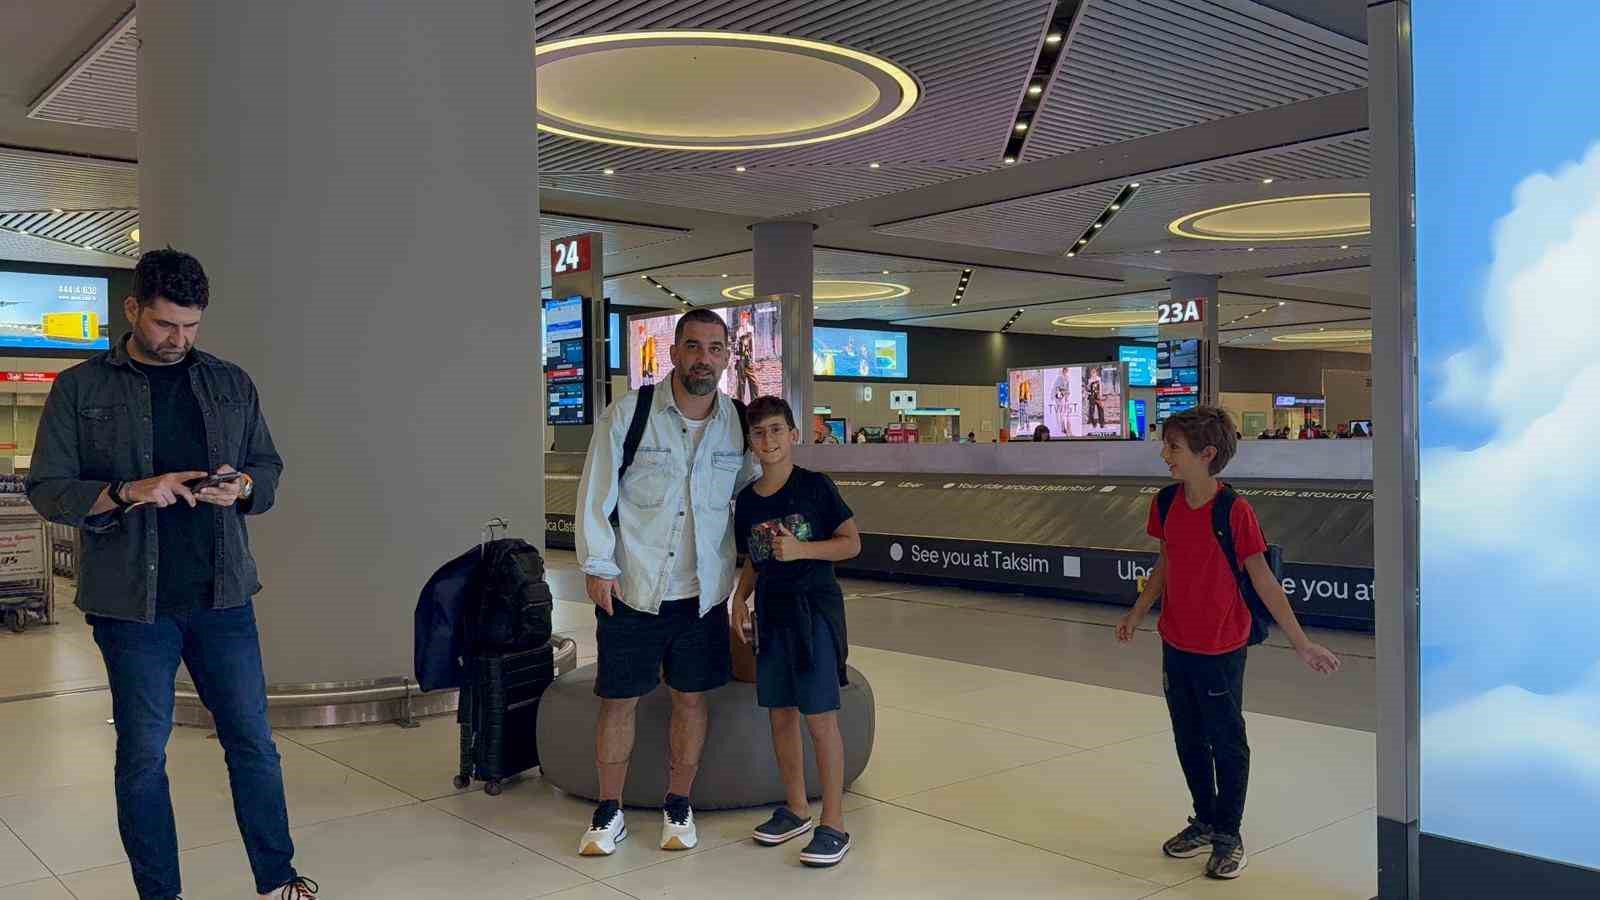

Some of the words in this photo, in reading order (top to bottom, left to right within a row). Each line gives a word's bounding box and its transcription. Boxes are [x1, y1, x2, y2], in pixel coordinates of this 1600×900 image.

[555, 241, 579, 272] 24
[1158, 301, 1200, 323] 23A
[1234, 488, 1262, 497] our
[1263, 488, 1297, 498] ride
[1297, 489, 1362, 500] around
[911, 544, 939, 563] See
[942, 550, 970, 568] you
[973, 551, 989, 568] at
[992, 551, 1049, 573] Taksim
[1117, 559, 1154, 581] Ube
[1301, 579, 1348, 602] you
